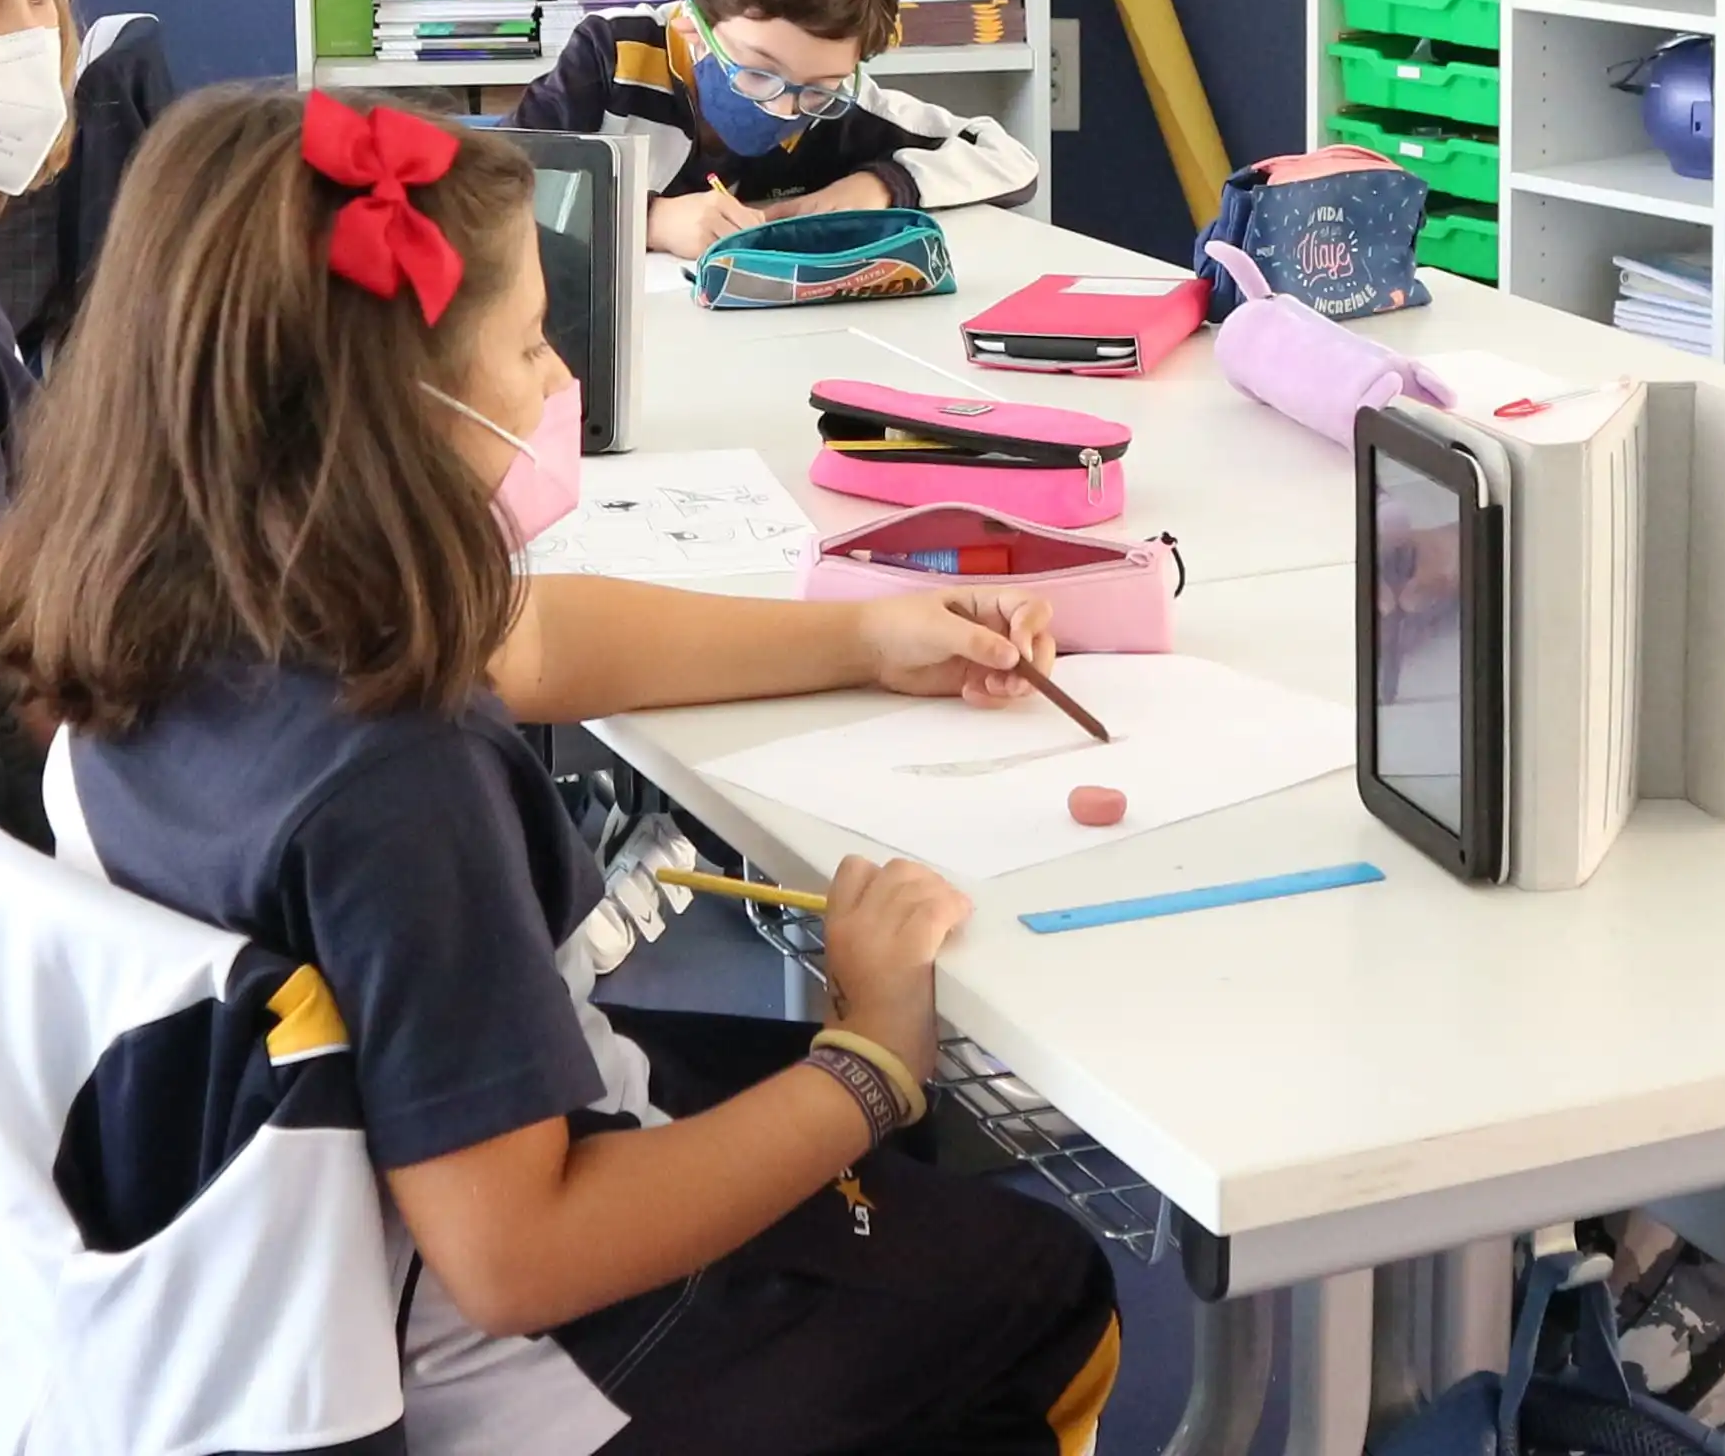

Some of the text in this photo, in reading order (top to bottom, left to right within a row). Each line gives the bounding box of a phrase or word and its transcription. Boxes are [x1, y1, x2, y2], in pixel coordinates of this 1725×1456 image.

[1316, 206, 1343, 222] VIDA
[1297, 231, 1354, 279] Viaje
[1314, 283, 1377, 314] INCREÍBLE
